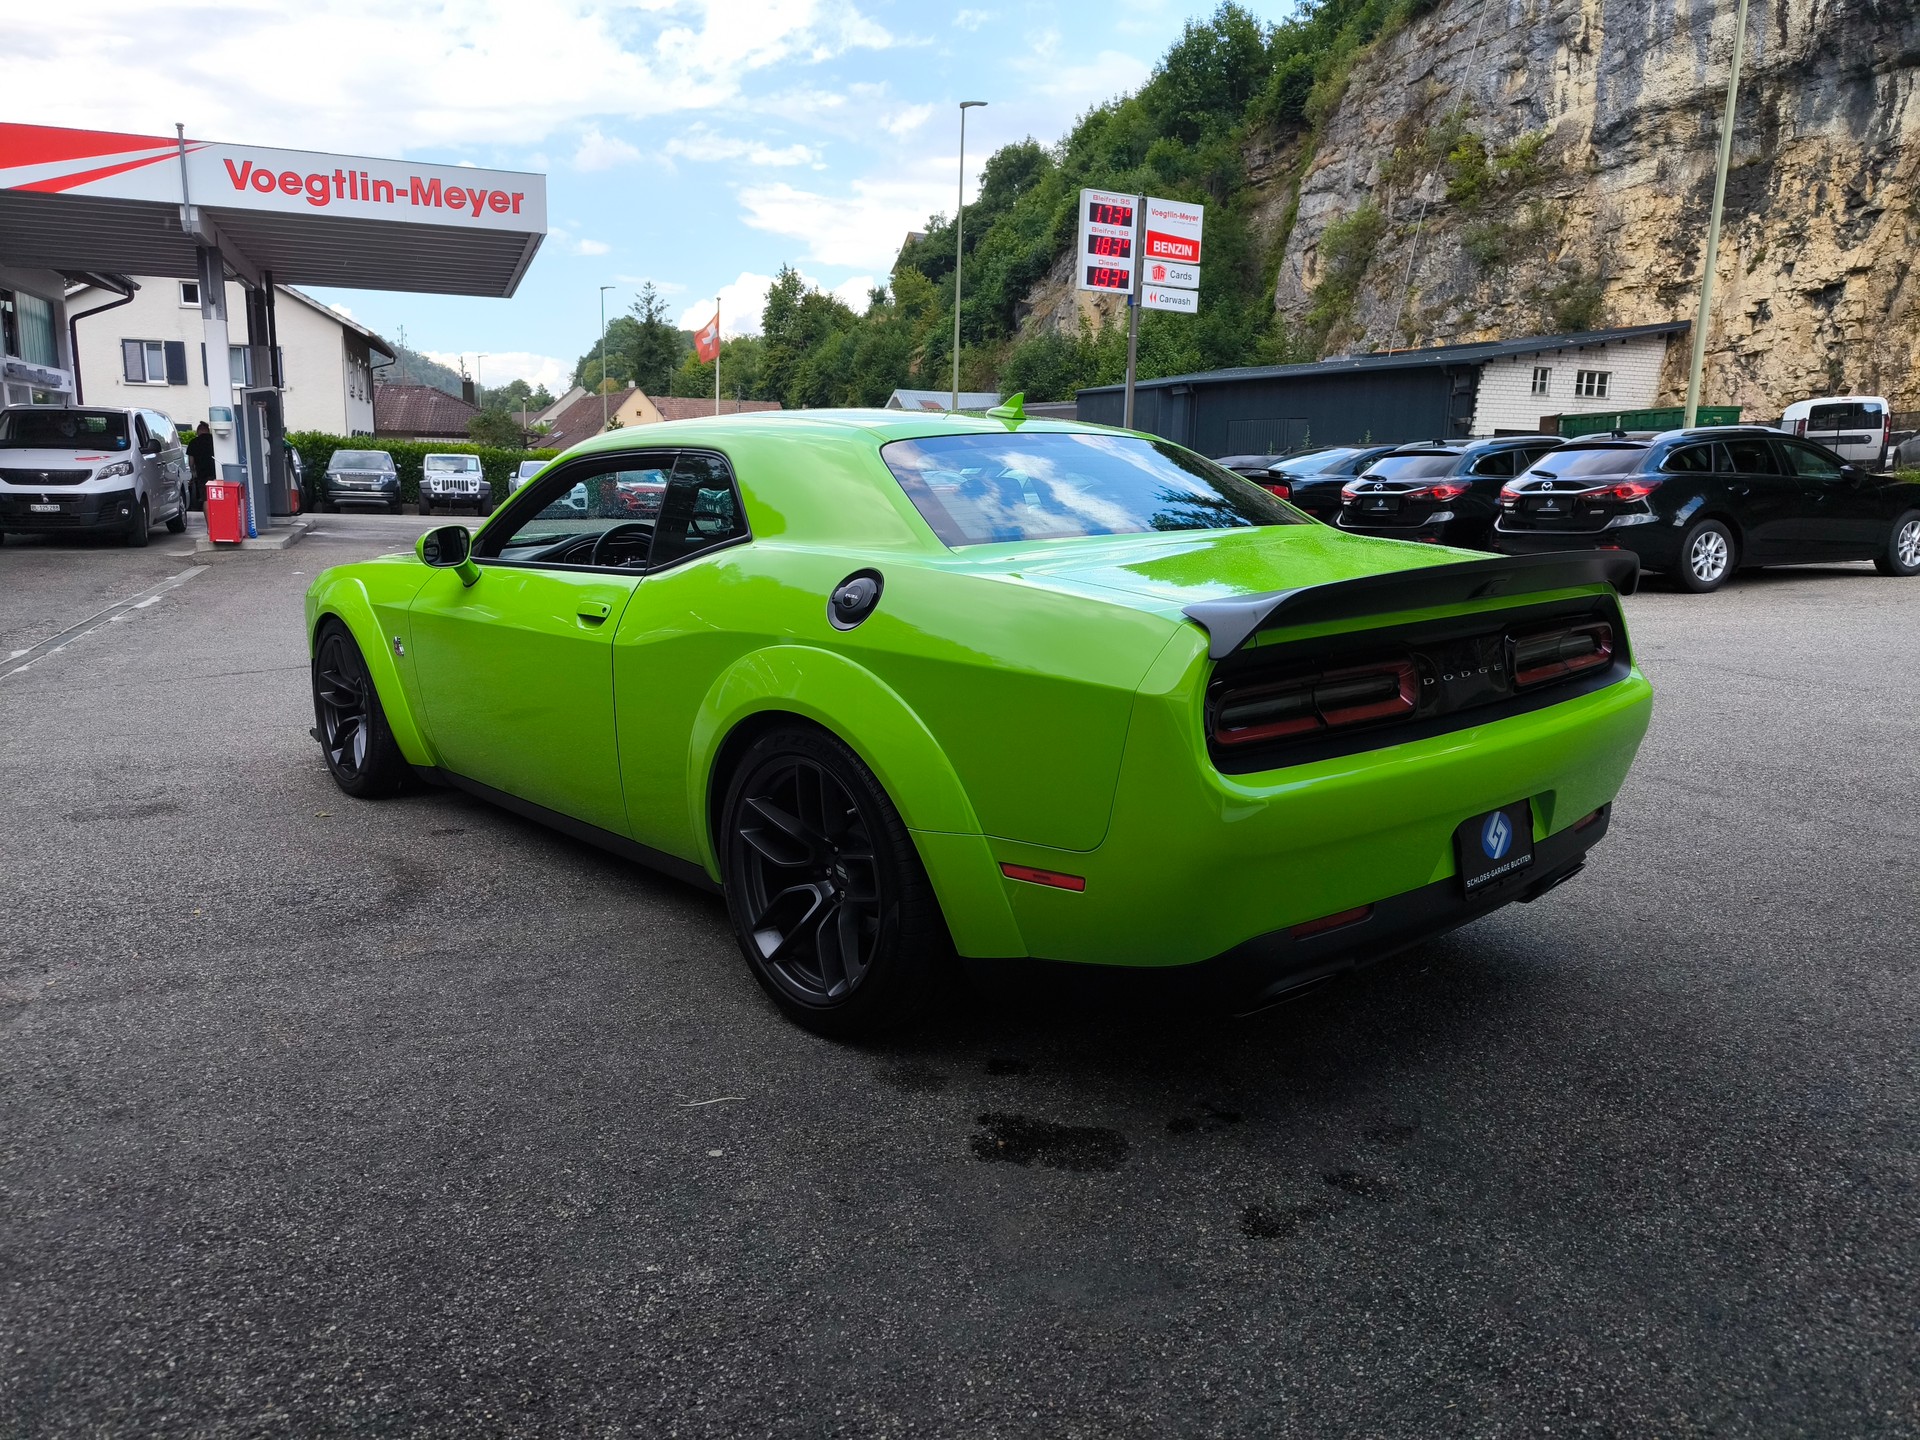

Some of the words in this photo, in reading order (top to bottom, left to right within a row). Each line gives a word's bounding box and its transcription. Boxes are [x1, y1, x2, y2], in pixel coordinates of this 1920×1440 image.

[223, 158, 525, 218] Voegtlin-Meyer
[1092, 194, 1118, 203] Bleifrei
[1151, 208, 1199, 222] Voegtlin-Meyer
[1091, 226, 1117, 236] Bleifrei
[1153, 240, 1193, 256] BENZIN
[1098, 259, 1120, 267] Diesel
[1170, 270, 1192, 281] Cards
[1159, 294, 1191, 305] Carwash
[1423, 663, 1502, 685] DODGE
[1466, 864, 1510, 888] SCHLOSS-GARAGE
